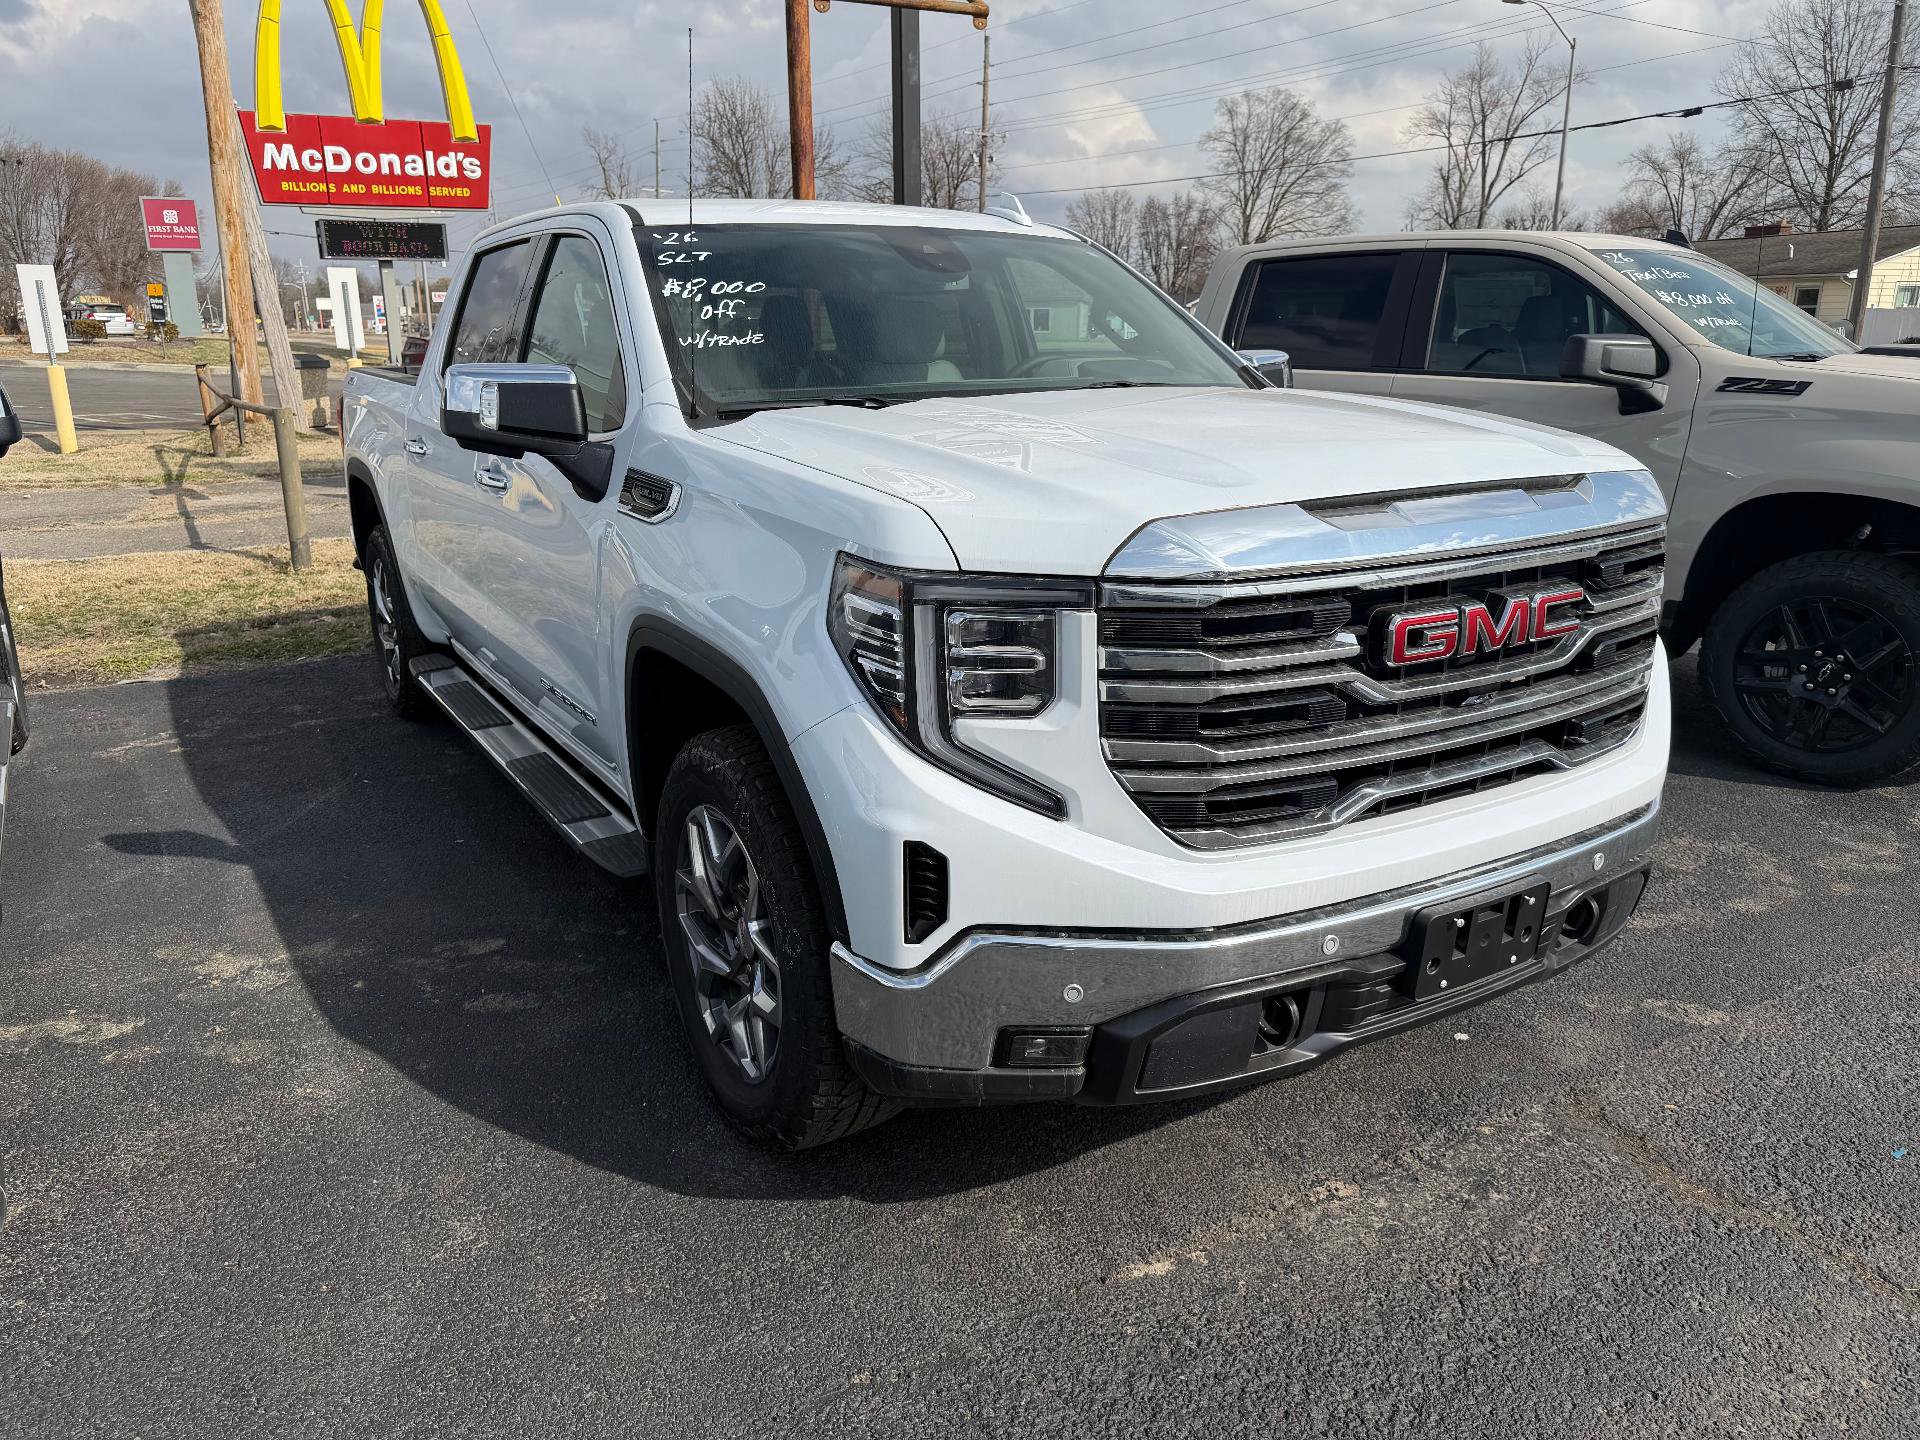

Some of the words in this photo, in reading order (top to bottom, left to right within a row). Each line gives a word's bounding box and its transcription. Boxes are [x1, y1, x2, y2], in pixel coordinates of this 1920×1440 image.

[262, 142, 482, 180] McDonald's
[281, 181, 336, 193] BILLIONS
[342, 183, 366, 194] AND
[371, 184, 423, 196] BILLIONS
[429, 186, 471, 197] SERVED
[148, 225, 172, 233] FIRST
[173, 225, 197, 233] BANK
[657, 251, 713, 266] SLT
[1386, 588, 1584, 667] GMC
